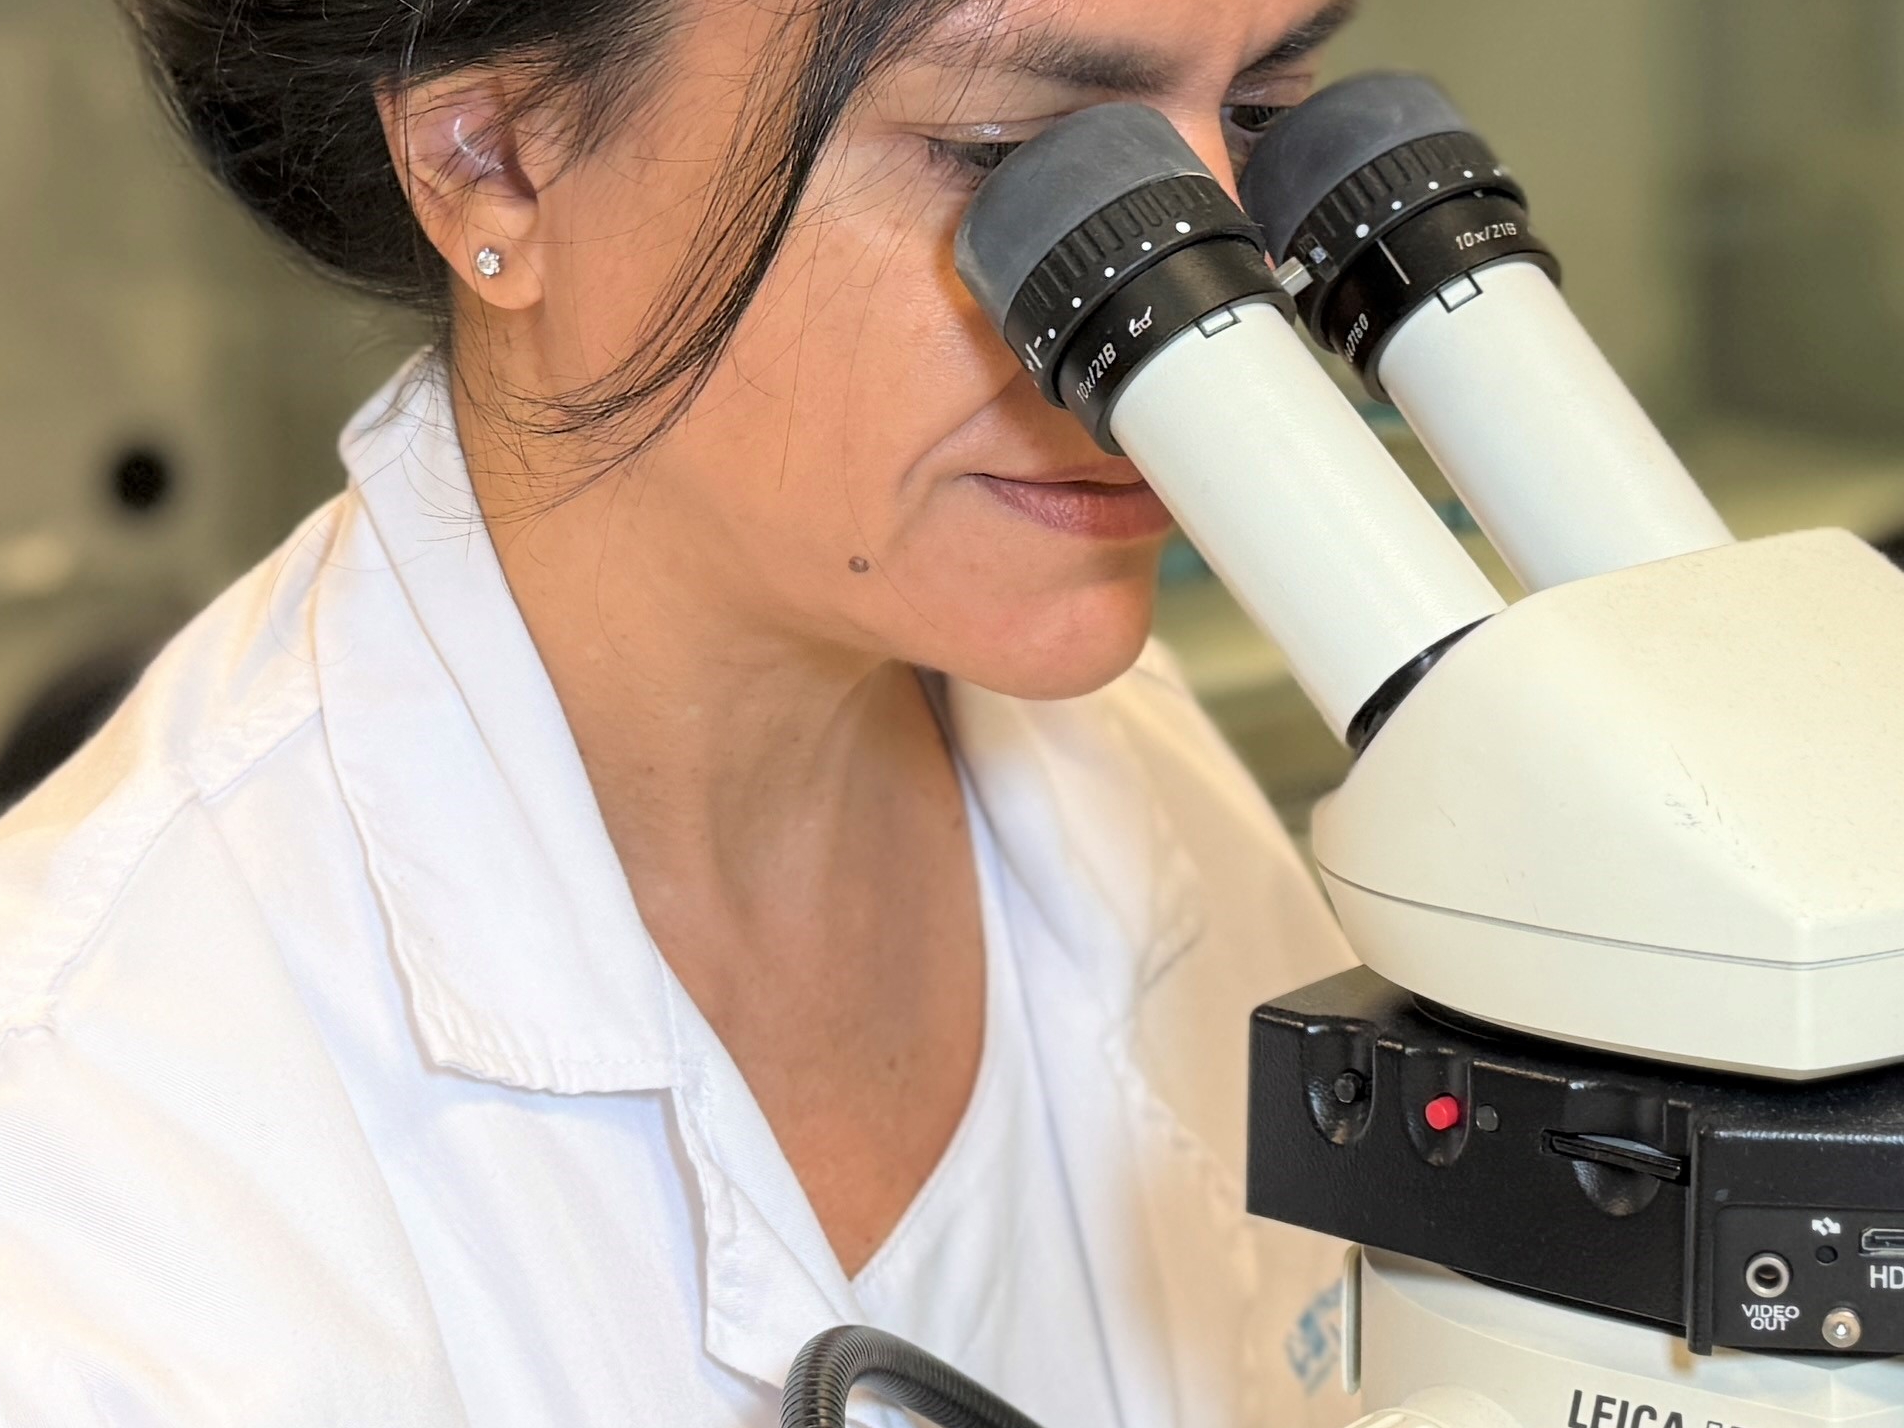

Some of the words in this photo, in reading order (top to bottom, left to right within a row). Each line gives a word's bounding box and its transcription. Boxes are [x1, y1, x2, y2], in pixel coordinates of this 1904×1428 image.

[1076, 342, 1117, 404] 10x/21B
[1742, 1304, 1800, 1320] VIDEO
[1750, 1317, 1789, 1331] OUT
